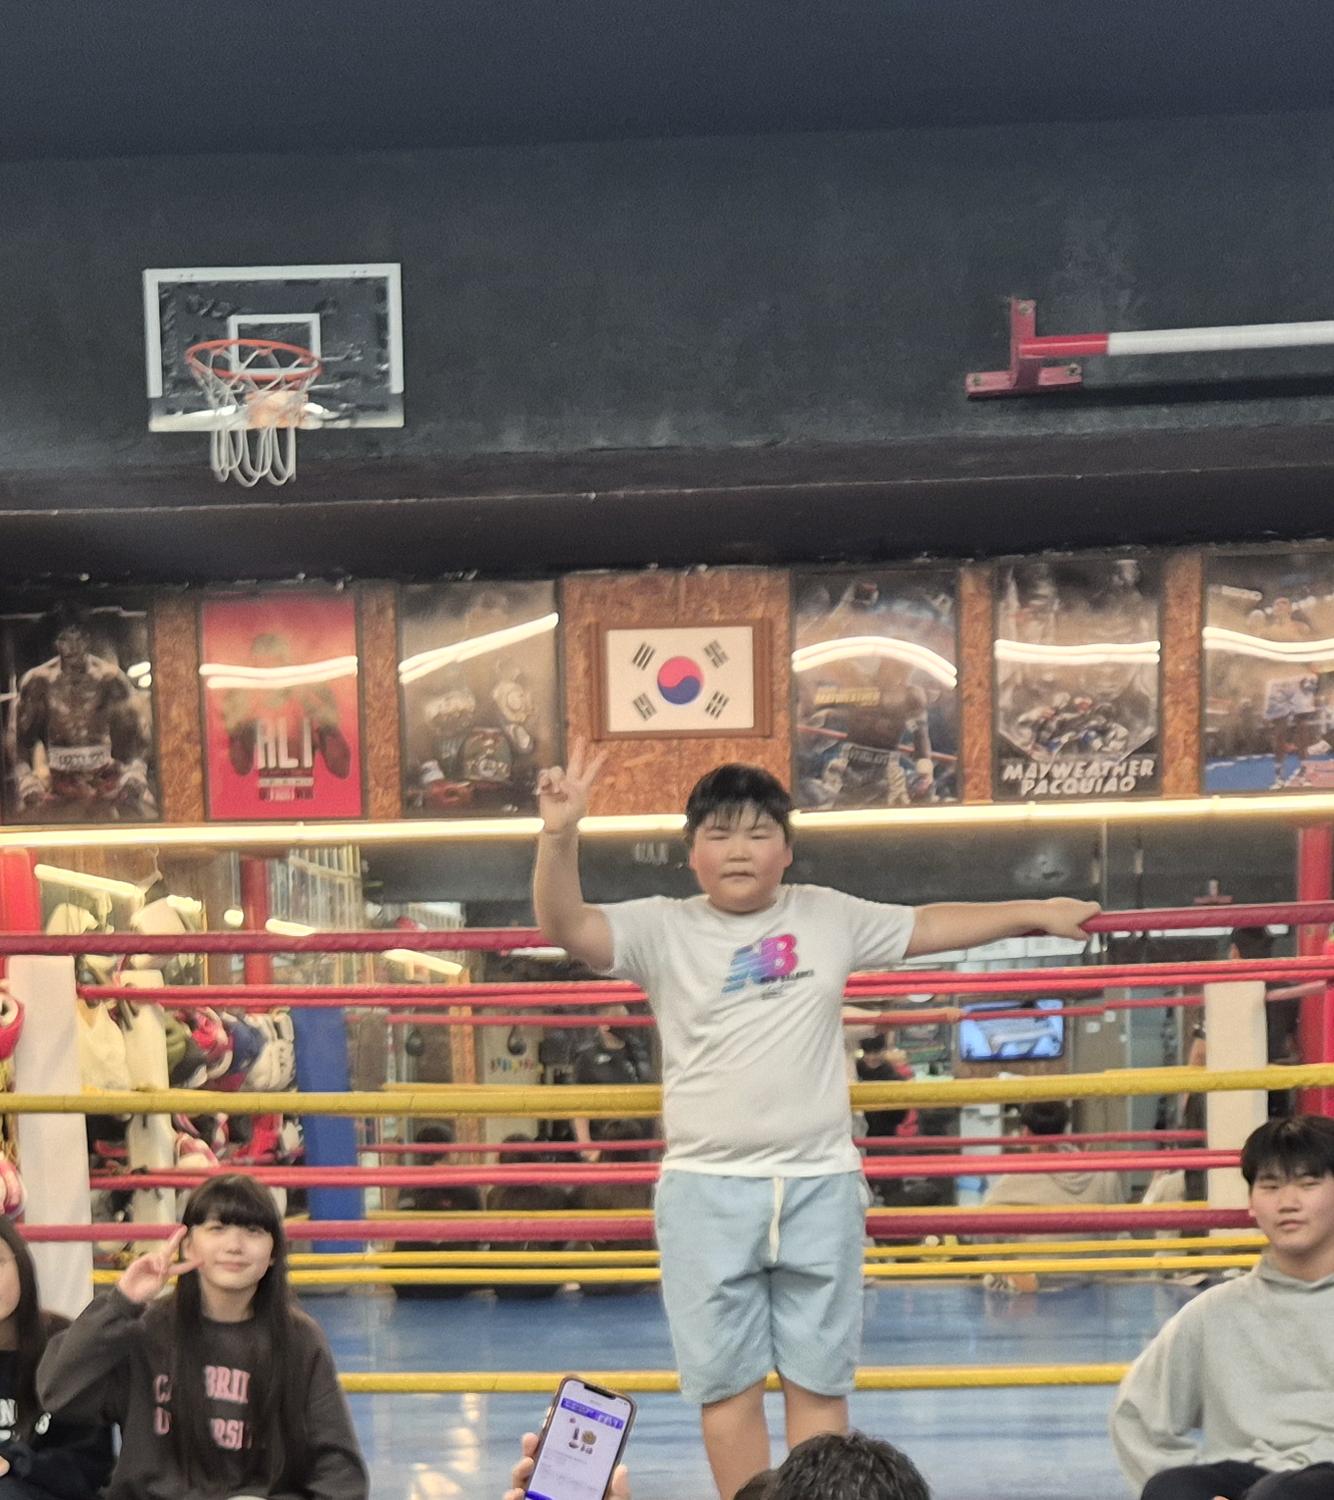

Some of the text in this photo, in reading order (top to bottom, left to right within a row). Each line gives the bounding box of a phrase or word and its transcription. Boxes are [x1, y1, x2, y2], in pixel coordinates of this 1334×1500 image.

[257, 718, 314, 769] ALI
[1002, 758, 1155, 781] MAYWEATHER
[1020, 776, 1137, 796] PACQUIAO
